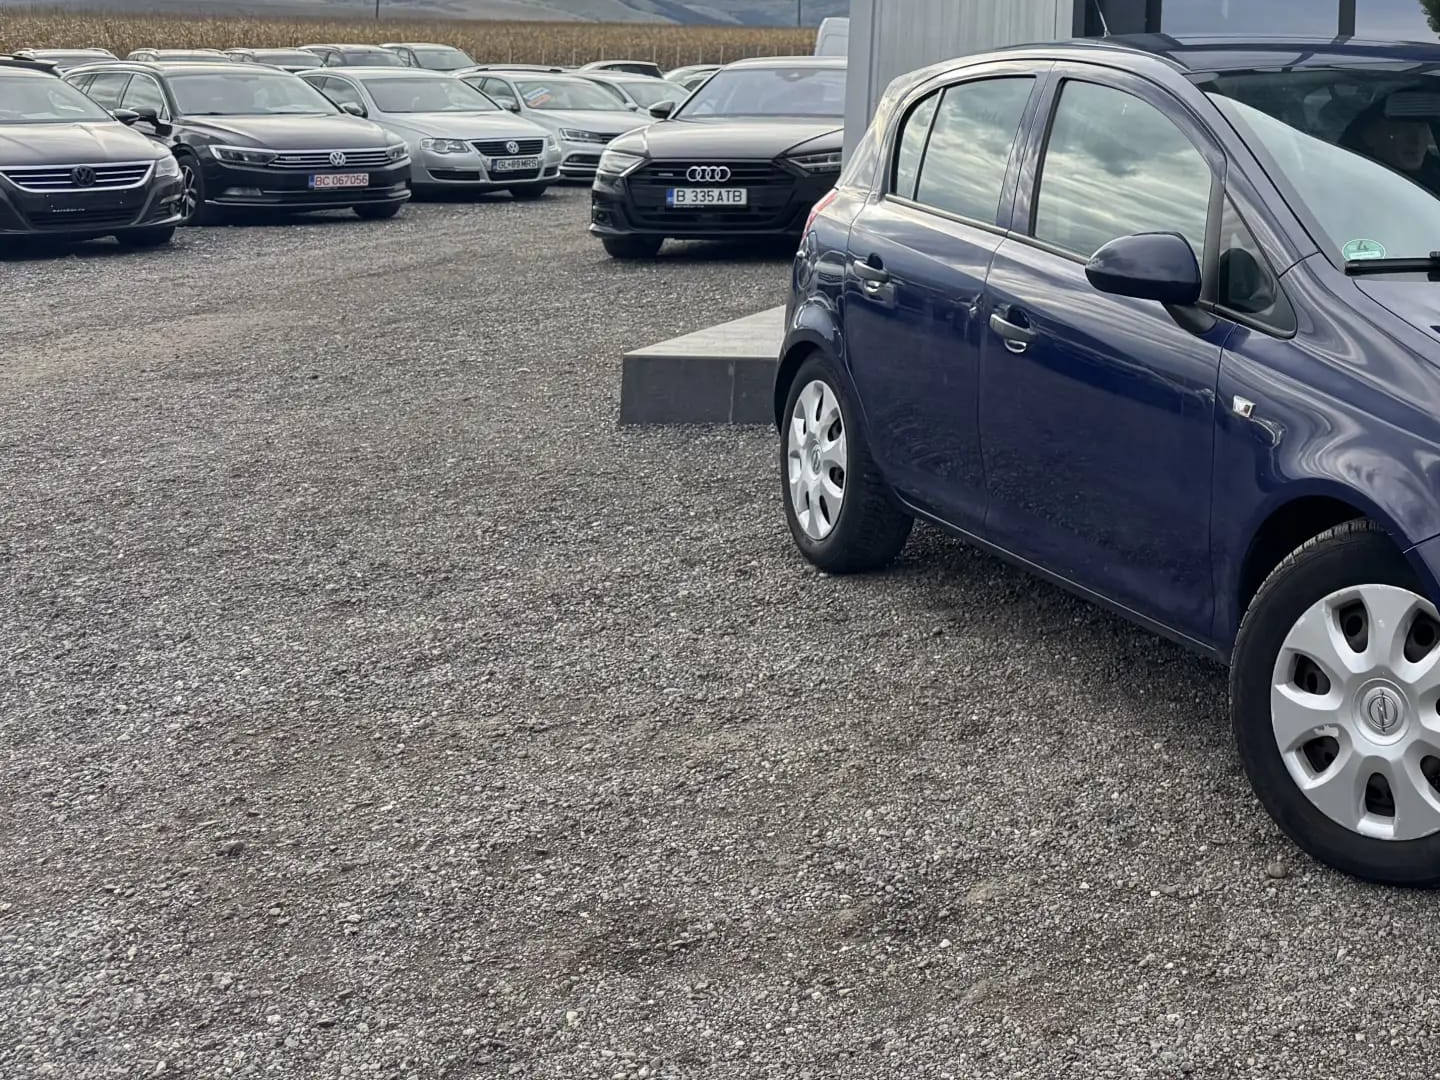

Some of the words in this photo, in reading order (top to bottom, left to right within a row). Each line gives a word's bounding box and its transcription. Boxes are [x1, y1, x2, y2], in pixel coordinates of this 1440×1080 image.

[315, 176, 330, 186] BC
[332, 174, 368, 185] 067056
[676, 190, 686, 202] B
